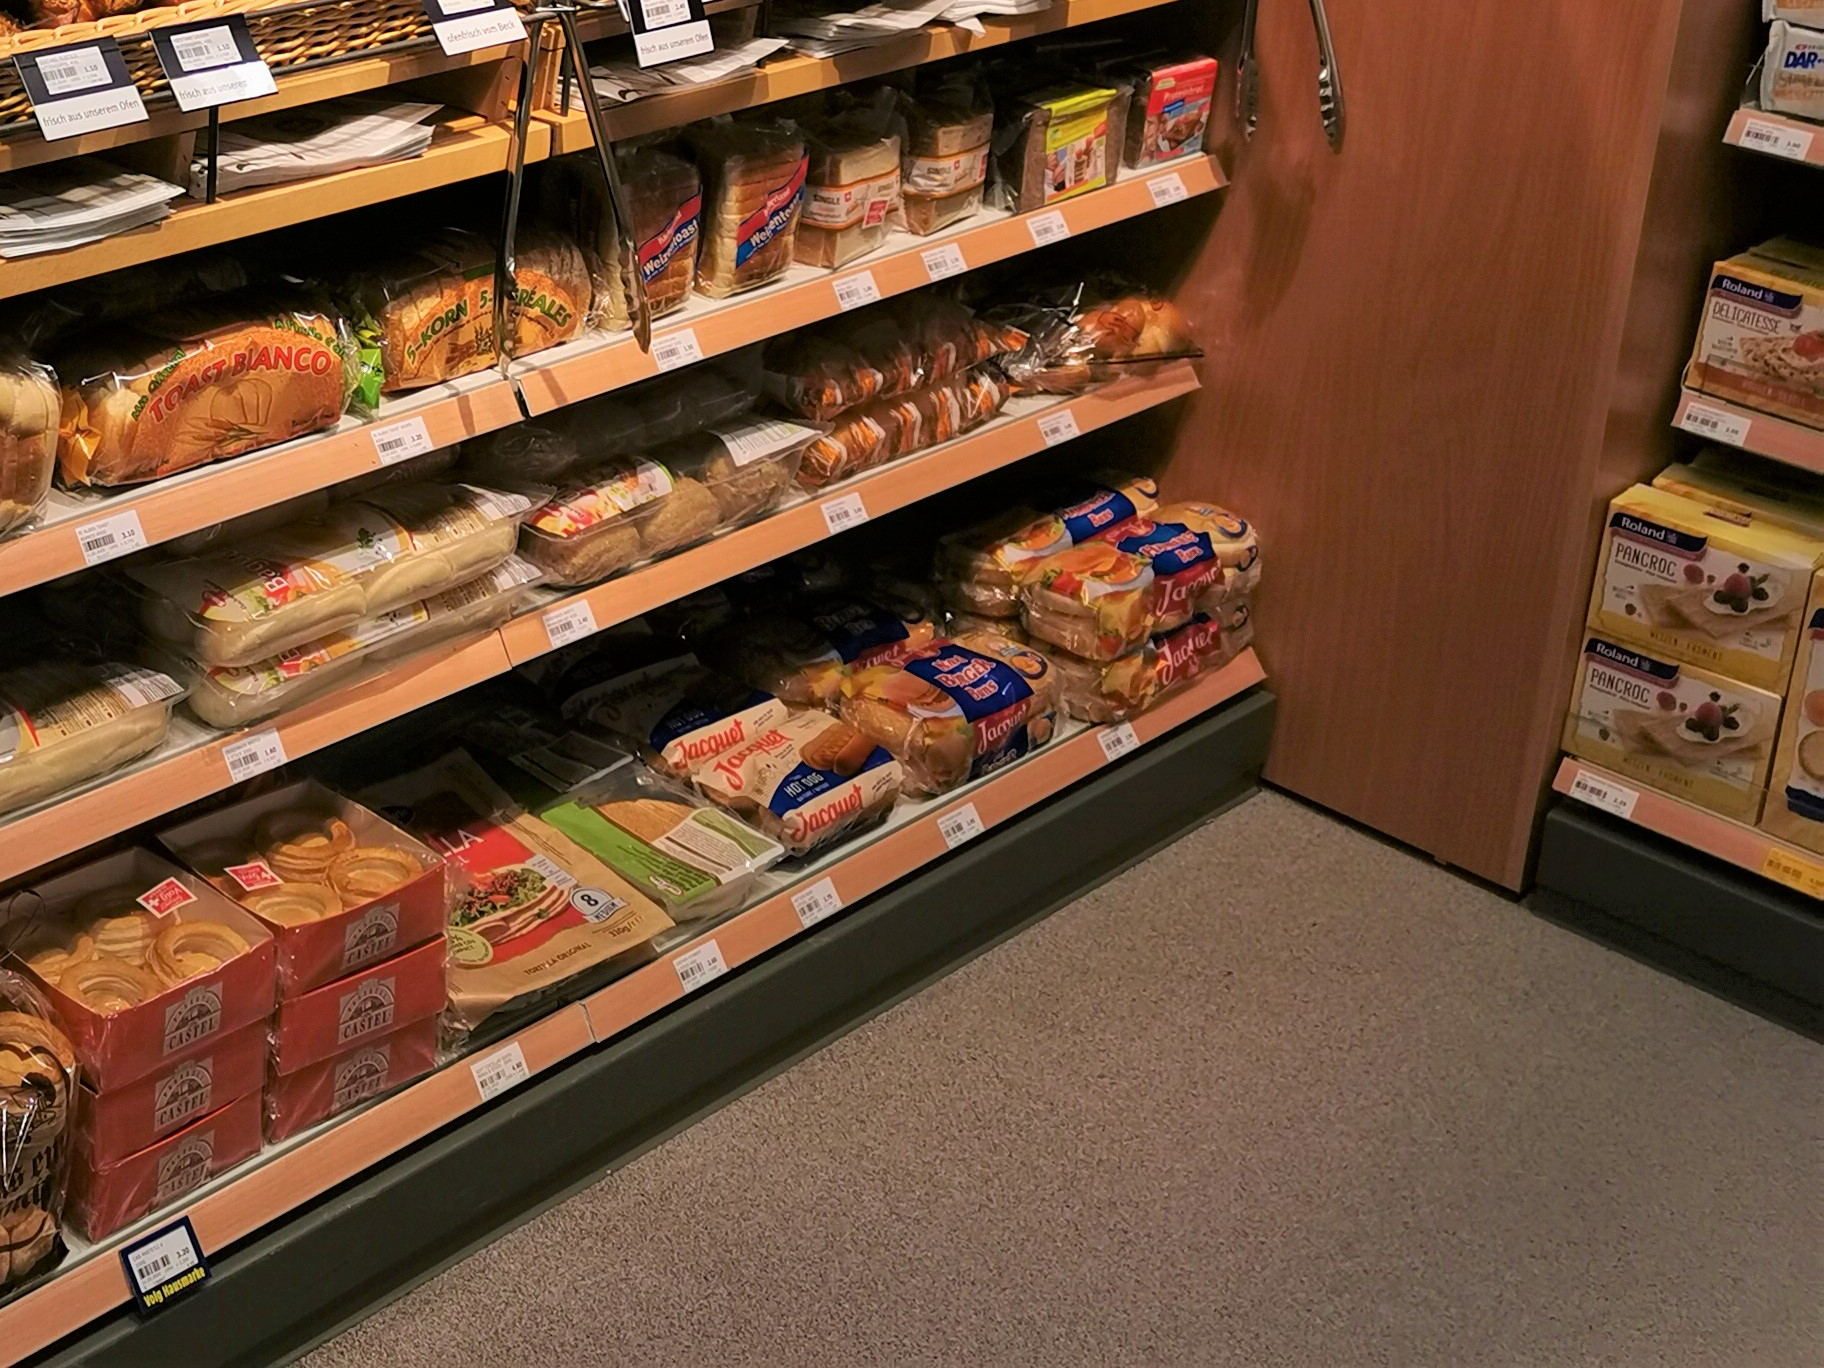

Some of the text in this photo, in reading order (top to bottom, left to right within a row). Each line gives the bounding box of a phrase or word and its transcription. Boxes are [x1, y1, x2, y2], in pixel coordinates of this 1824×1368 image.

[42, 99, 139, 127] frisch aus unserem Ofen
[1722, 279, 1763, 300] Roland
[406, 299, 469, 365] 5-KORN
[479, 285, 572, 328] 5-RÉALES
[147, 346, 332, 424] TOAST BIANCO
[1621, 516, 1665, 541] Roland
[1615, 543, 1677, 578] PANCROC
[1596, 643, 1639, 668] Roland
[1589, 669, 1651, 704] PANCROC
[673, 718, 745, 770] Jacquet
[713, 728, 794, 792] Jacquet
[783, 771, 825, 797] HOT DOG
[788, 783, 862, 844] Jacquet
[580, 894, 598, 907] 8
[168, 1018, 216, 1052] CASTEL
[343, 1009, 391, 1039] CASTEL
[143, 1289, 162, 1308] Volg
